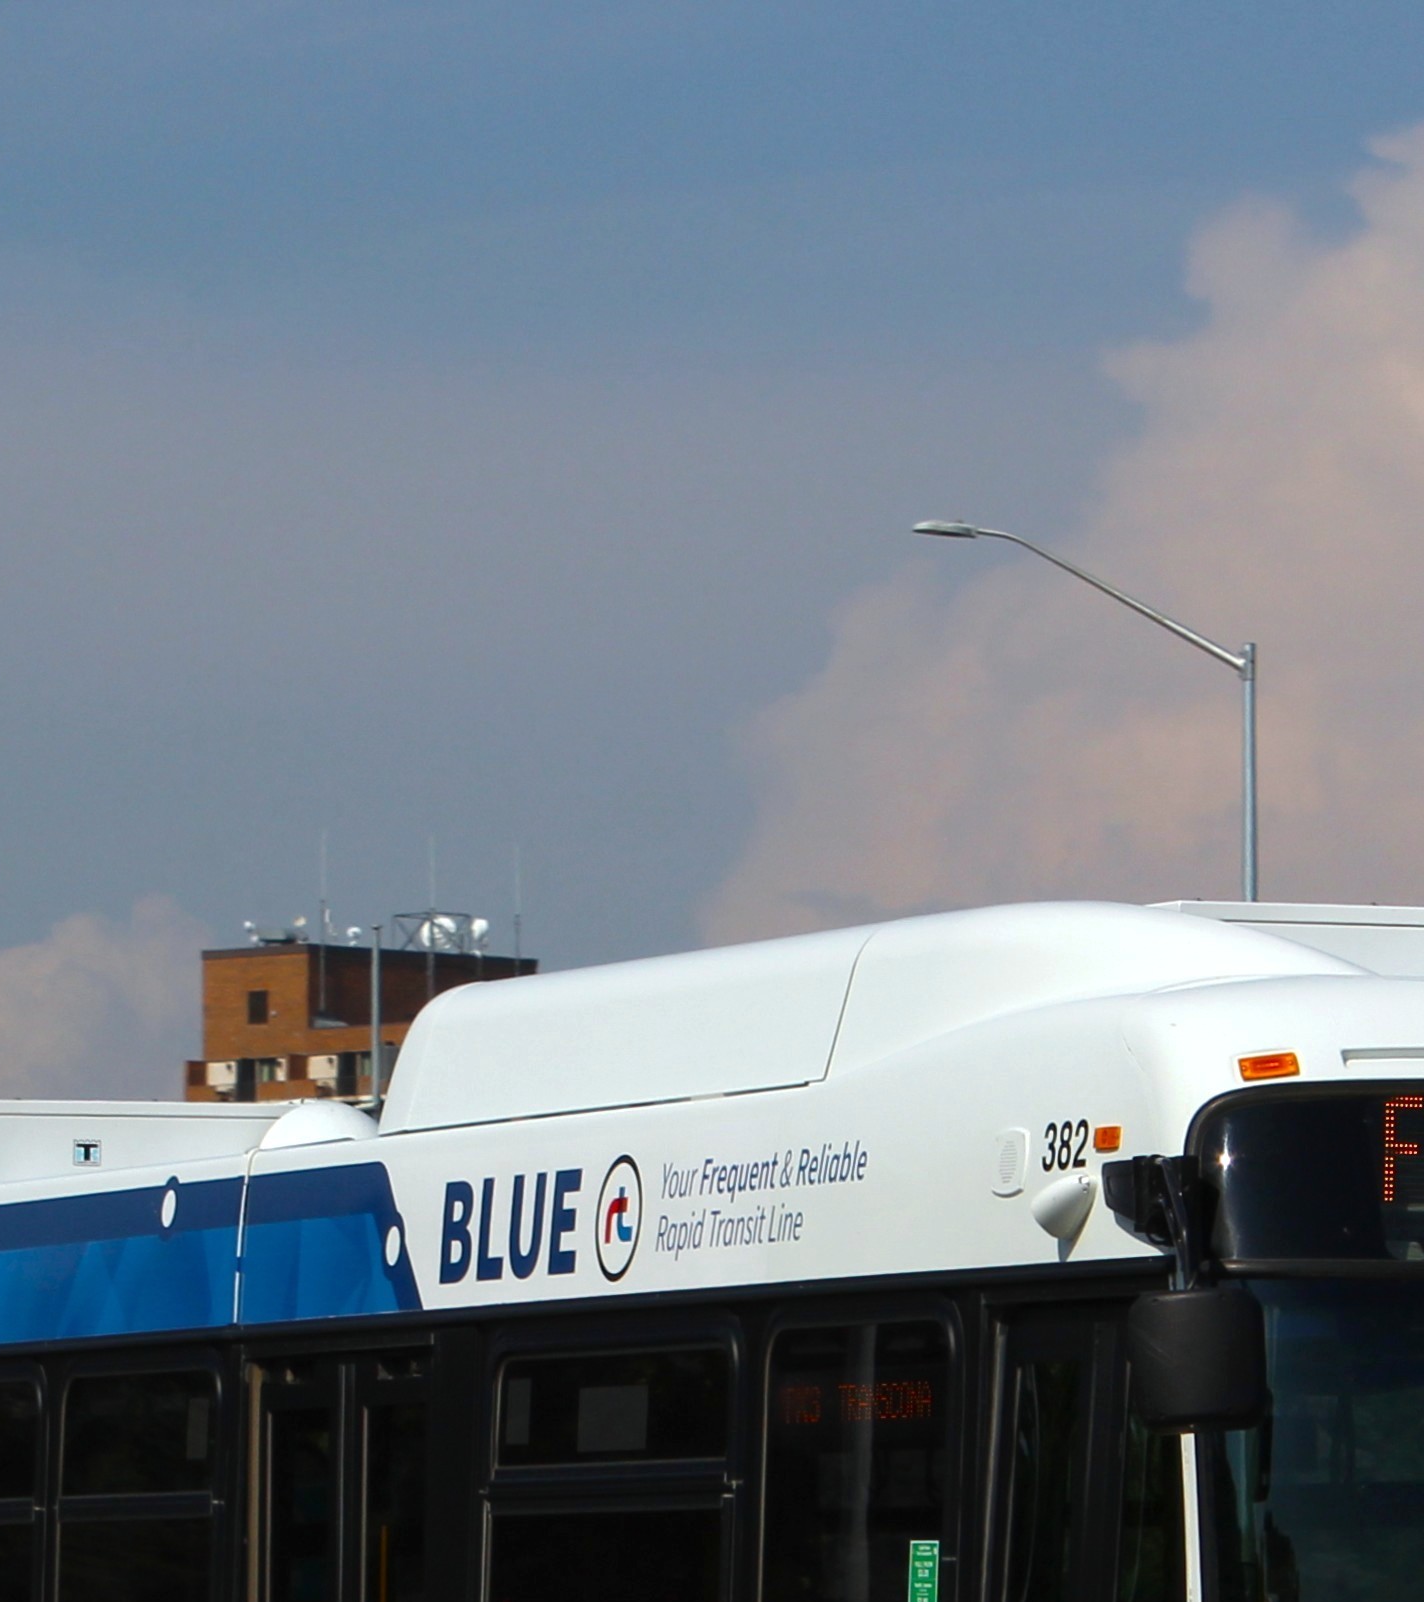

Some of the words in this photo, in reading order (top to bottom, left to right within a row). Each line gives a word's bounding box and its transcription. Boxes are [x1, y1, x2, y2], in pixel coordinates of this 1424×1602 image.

[660, 1162, 698, 1200] Your
[699, 1151, 778, 1203] Frequent
[779, 1149, 793, 1188] &
[795, 1139, 868, 1187] Reliable
[1042, 1118, 1089, 1172] 382
[439, 1168, 583, 1285] BLUE
[655, 1208, 707, 1261] Rapid
[708, 1204, 766, 1248] Transit
[767, 1202, 804, 1243] Line
